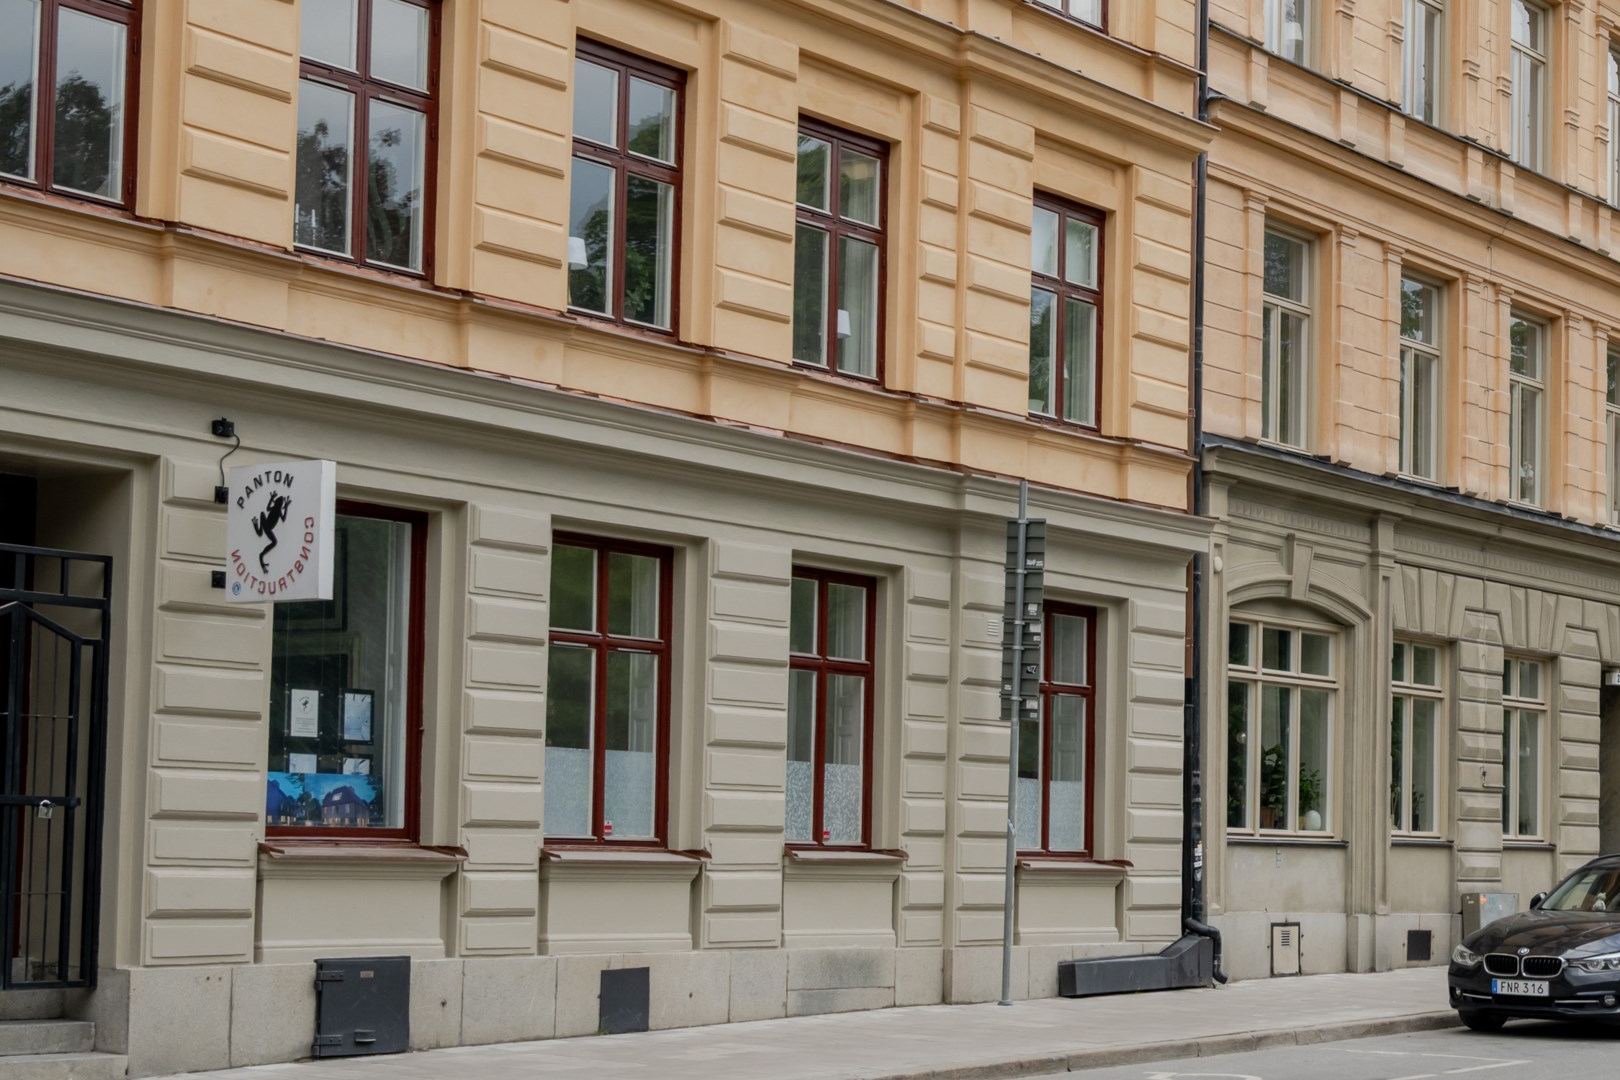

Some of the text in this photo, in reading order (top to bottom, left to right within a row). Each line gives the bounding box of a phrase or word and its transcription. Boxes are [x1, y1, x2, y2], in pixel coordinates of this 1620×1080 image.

[237, 470, 294, 509] PANTON
[1501, 981, 1544, 994] FNR 316
